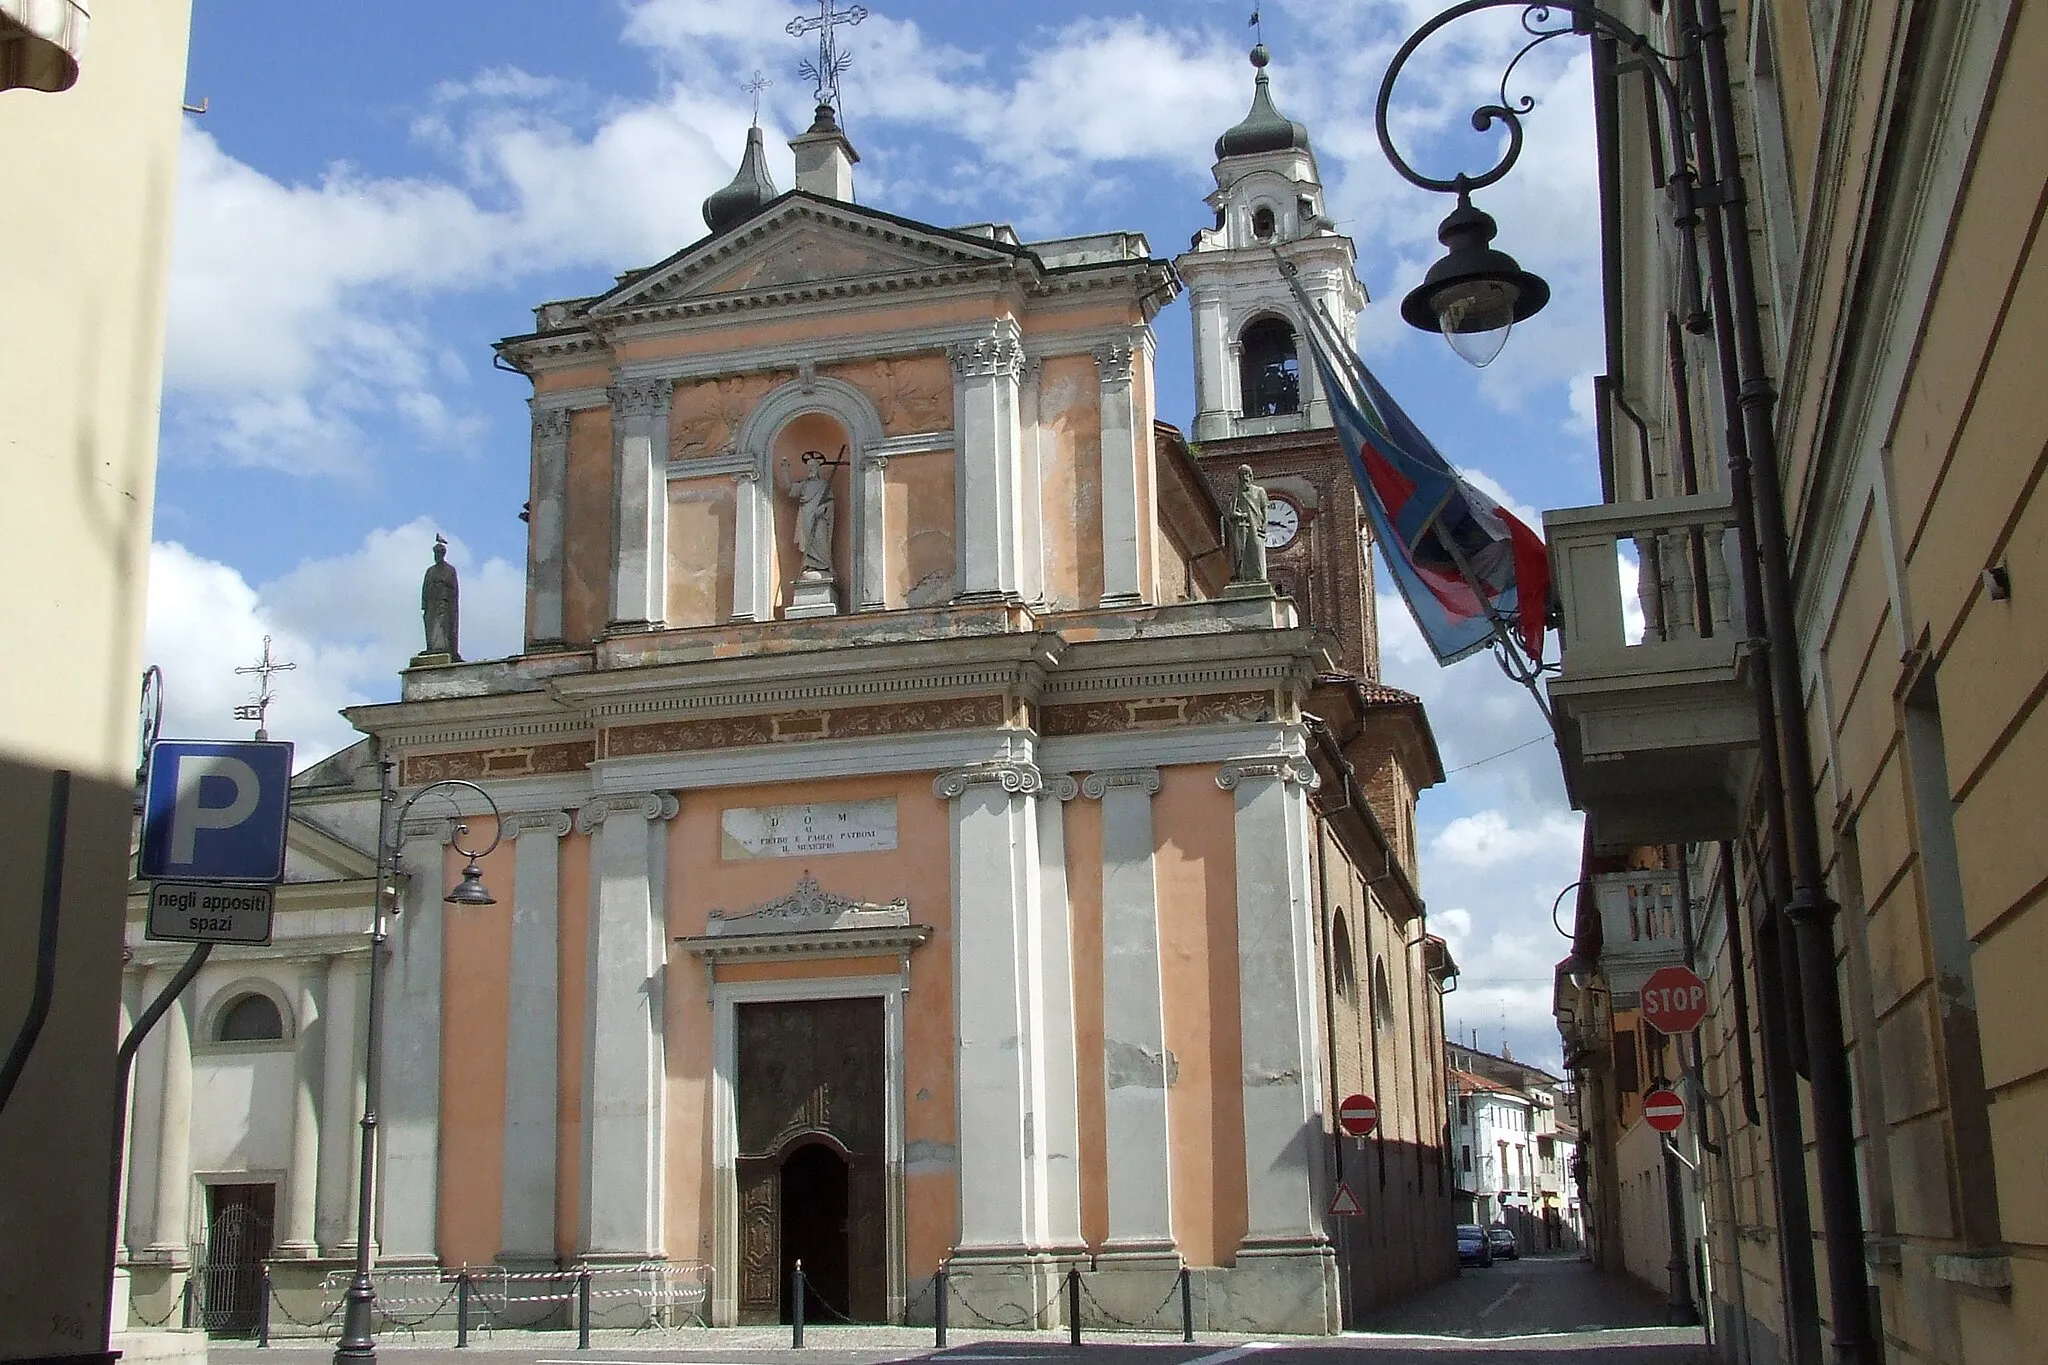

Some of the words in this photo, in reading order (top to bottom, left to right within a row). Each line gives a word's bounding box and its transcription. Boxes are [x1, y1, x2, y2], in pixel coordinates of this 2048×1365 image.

[171, 755, 260, 864] P
[803, 815, 812, 825] O
[838, 812, 847, 822] M
[760, 836, 788, 845] PIETRO
[807, 833, 834, 842] PAOLO
[840, 830, 876, 840] PATRONI
[797, 842, 836, 851] MUNICIPIO
[158, 891, 197, 912] negli
[202, 894, 266, 913] appositi
[189, 915, 233, 934] spazi
[1644, 985, 1704, 1014] STOP
